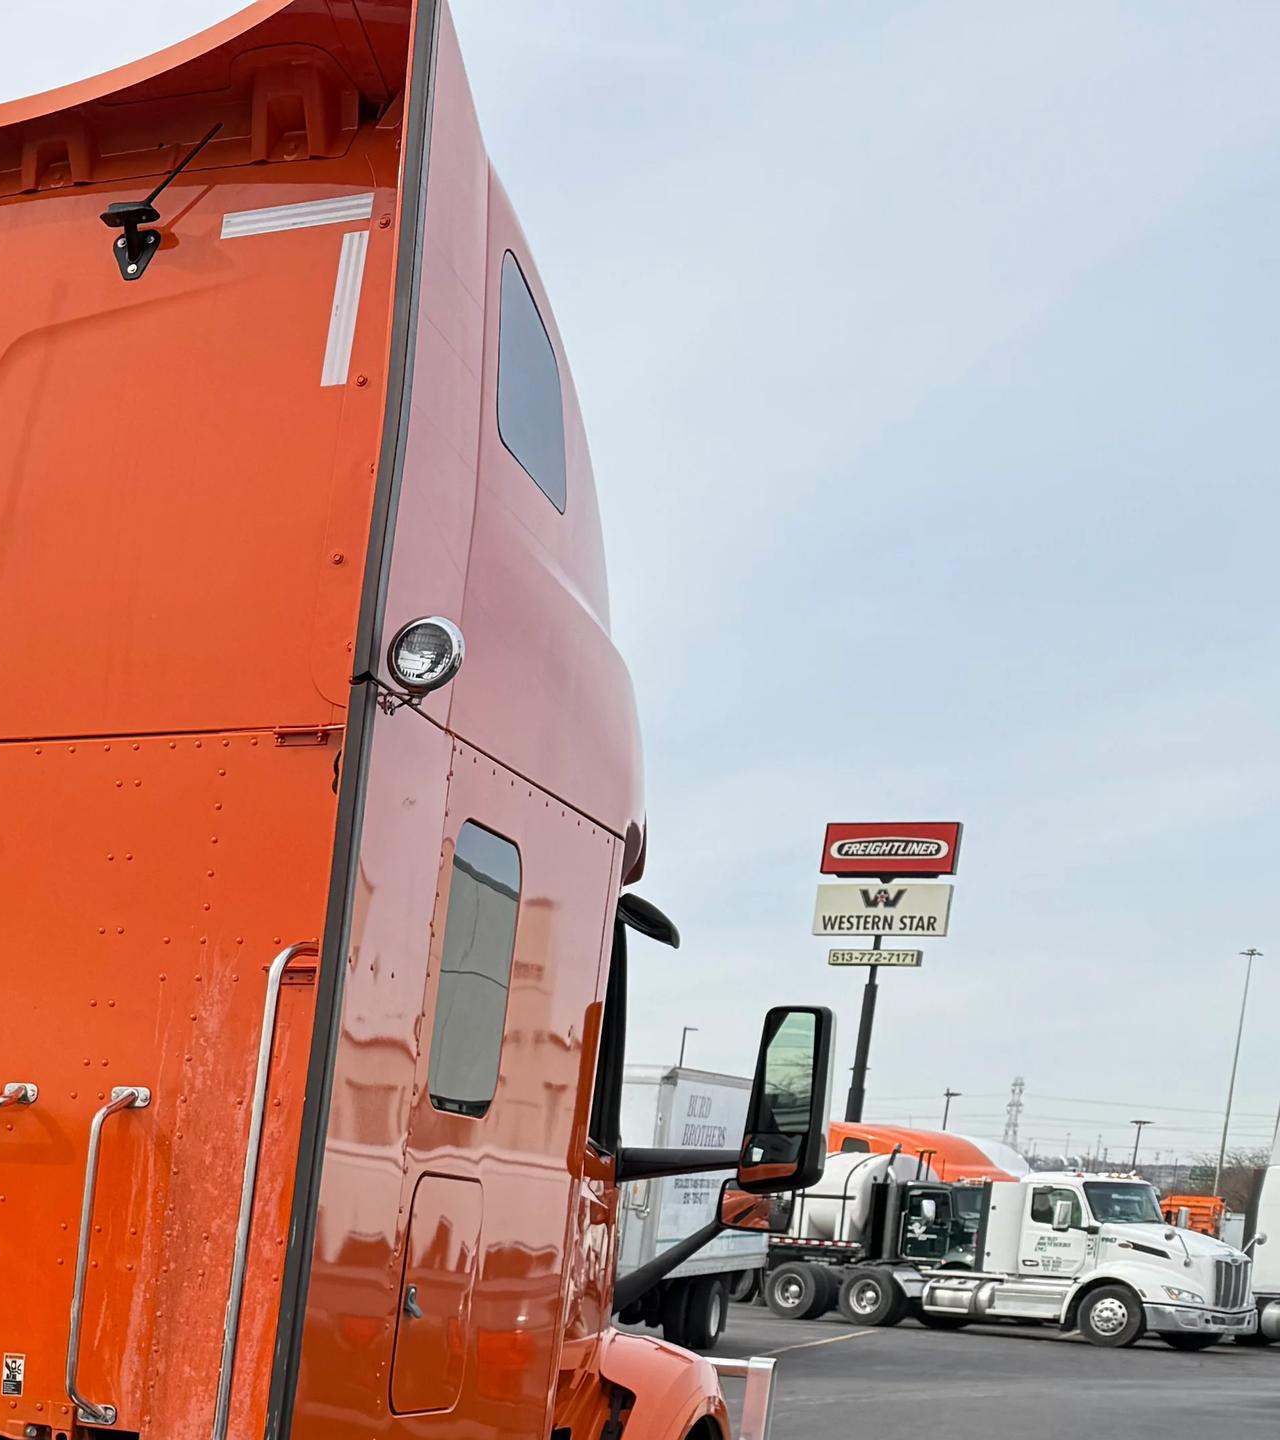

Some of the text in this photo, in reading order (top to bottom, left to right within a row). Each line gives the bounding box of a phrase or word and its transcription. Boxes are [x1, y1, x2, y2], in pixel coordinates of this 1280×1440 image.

[841, 841, 938, 855] FREIGHTLINER
[822, 915, 938, 931] WESTERN STAR
[832, 952, 915, 963] 513-772-7171
[687, 1094, 712, 1118] BURD
[681, 1123, 727, 1148] BROTHERS
